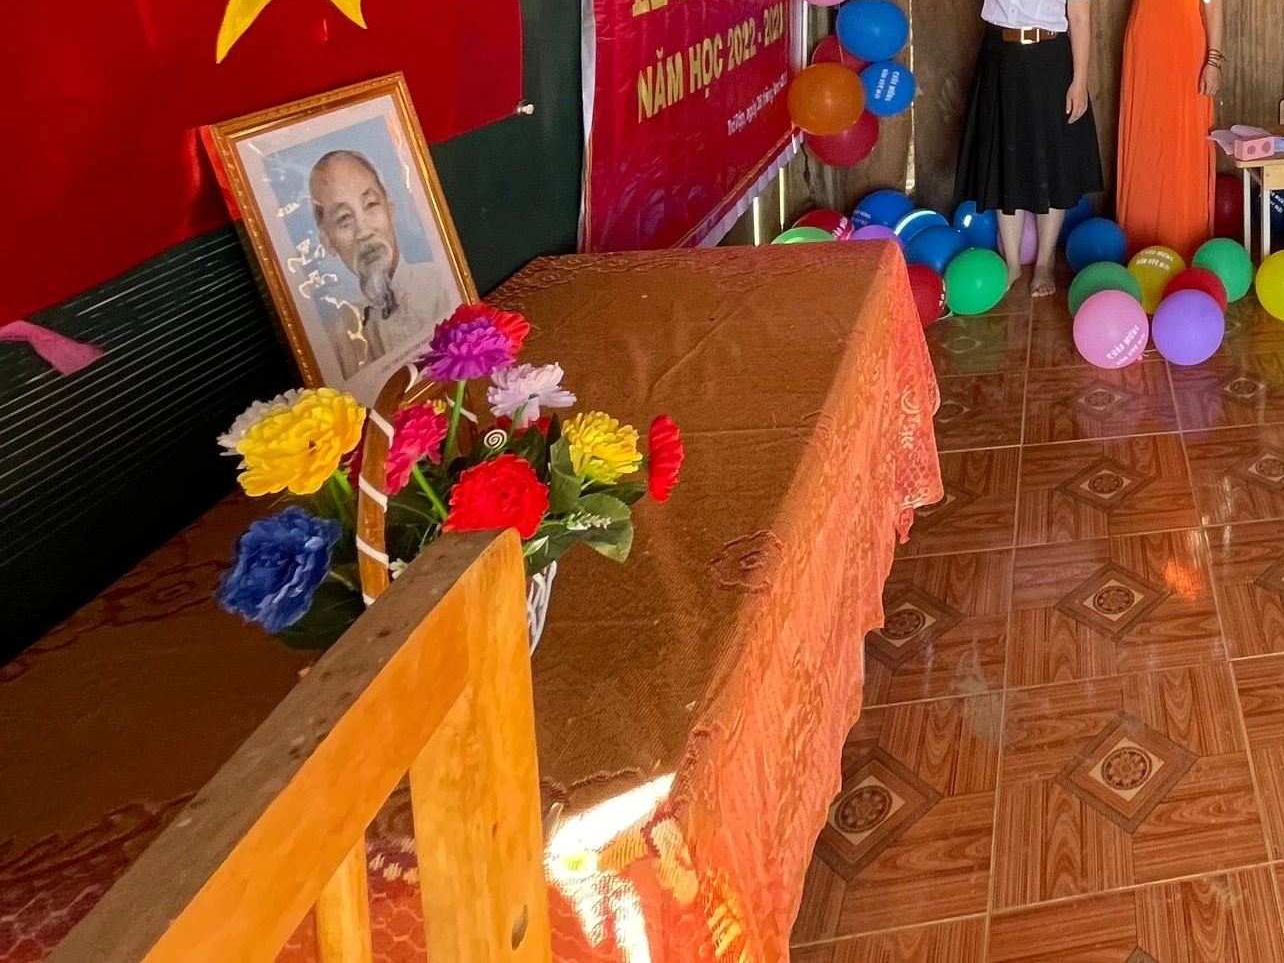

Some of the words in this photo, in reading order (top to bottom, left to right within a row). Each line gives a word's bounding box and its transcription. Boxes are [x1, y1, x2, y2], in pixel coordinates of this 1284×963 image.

[637, 48, 684, 125] NĂM
[689, 33, 723, 99] HỌC
[727, 17, 757, 72] 2022
